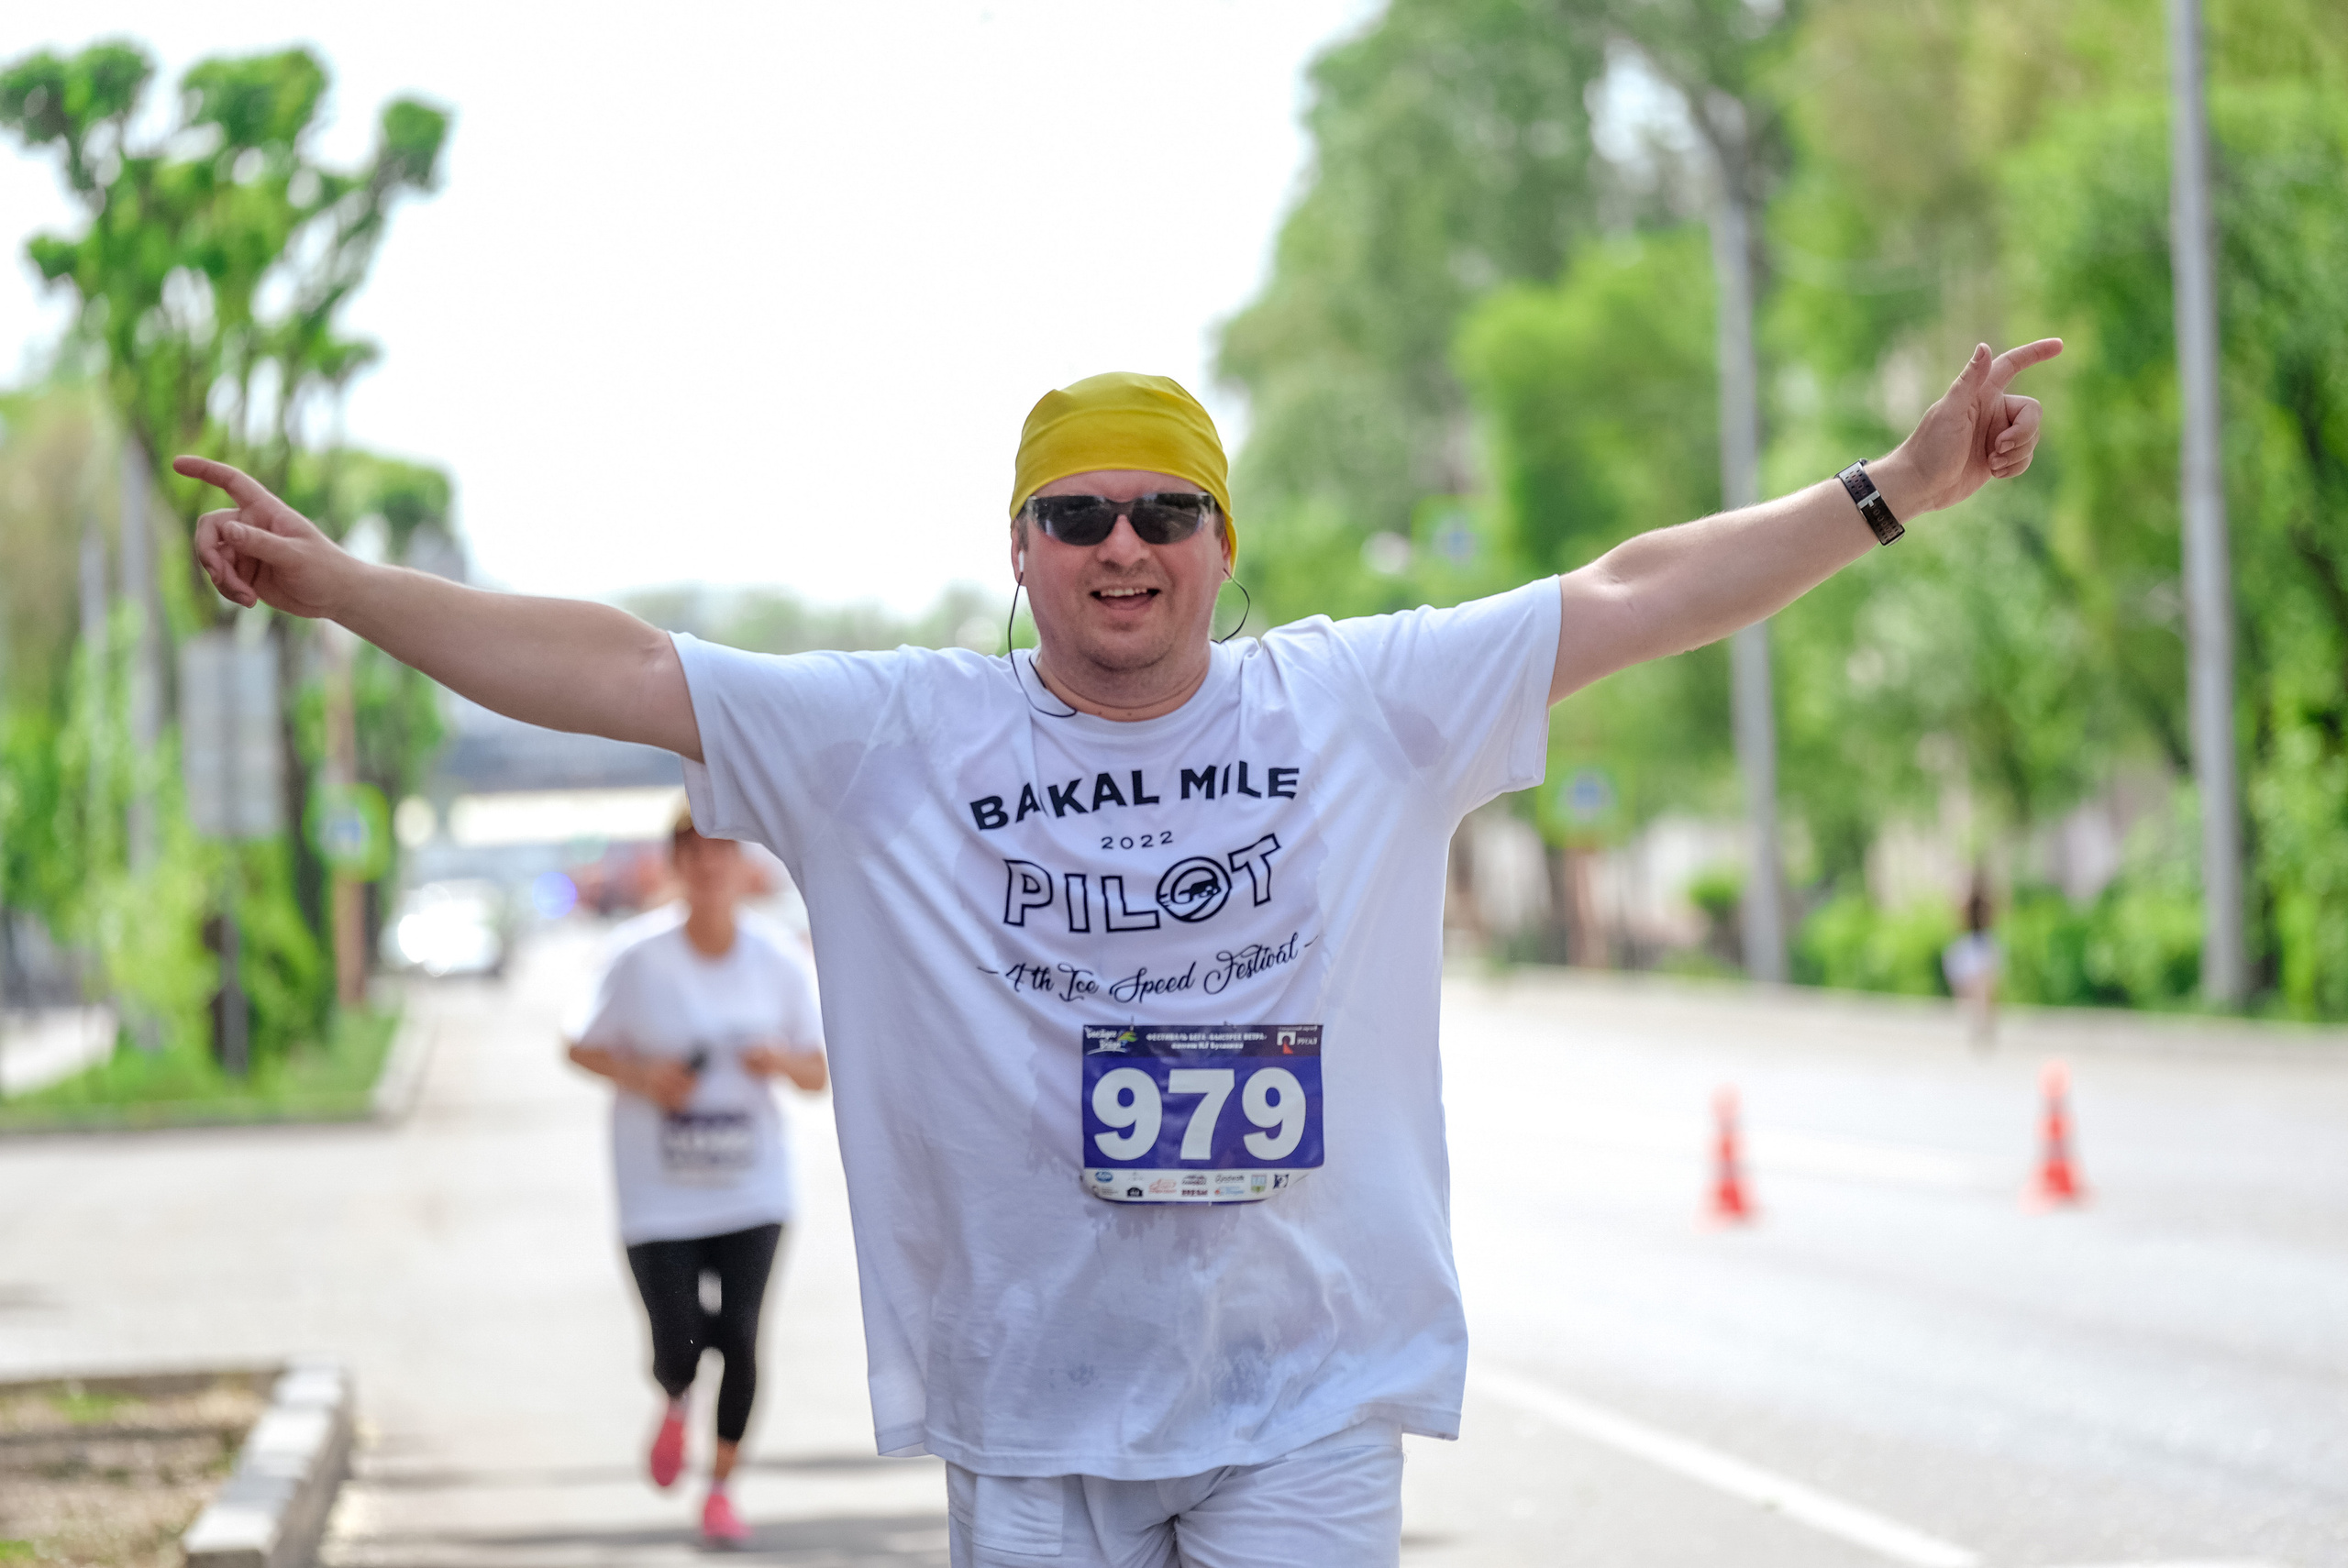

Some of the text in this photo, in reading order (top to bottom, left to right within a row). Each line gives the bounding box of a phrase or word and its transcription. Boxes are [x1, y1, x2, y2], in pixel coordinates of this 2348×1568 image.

[970, 760, 1300, 831] BAKAL MILE
[1101, 831, 1174, 850] 2022
[1003, 833, 1281, 933] PILOT
[1005, 932, 1300, 1004] 4th Ice Speed Festival
[1091, 1066, 1307, 1162] 979
